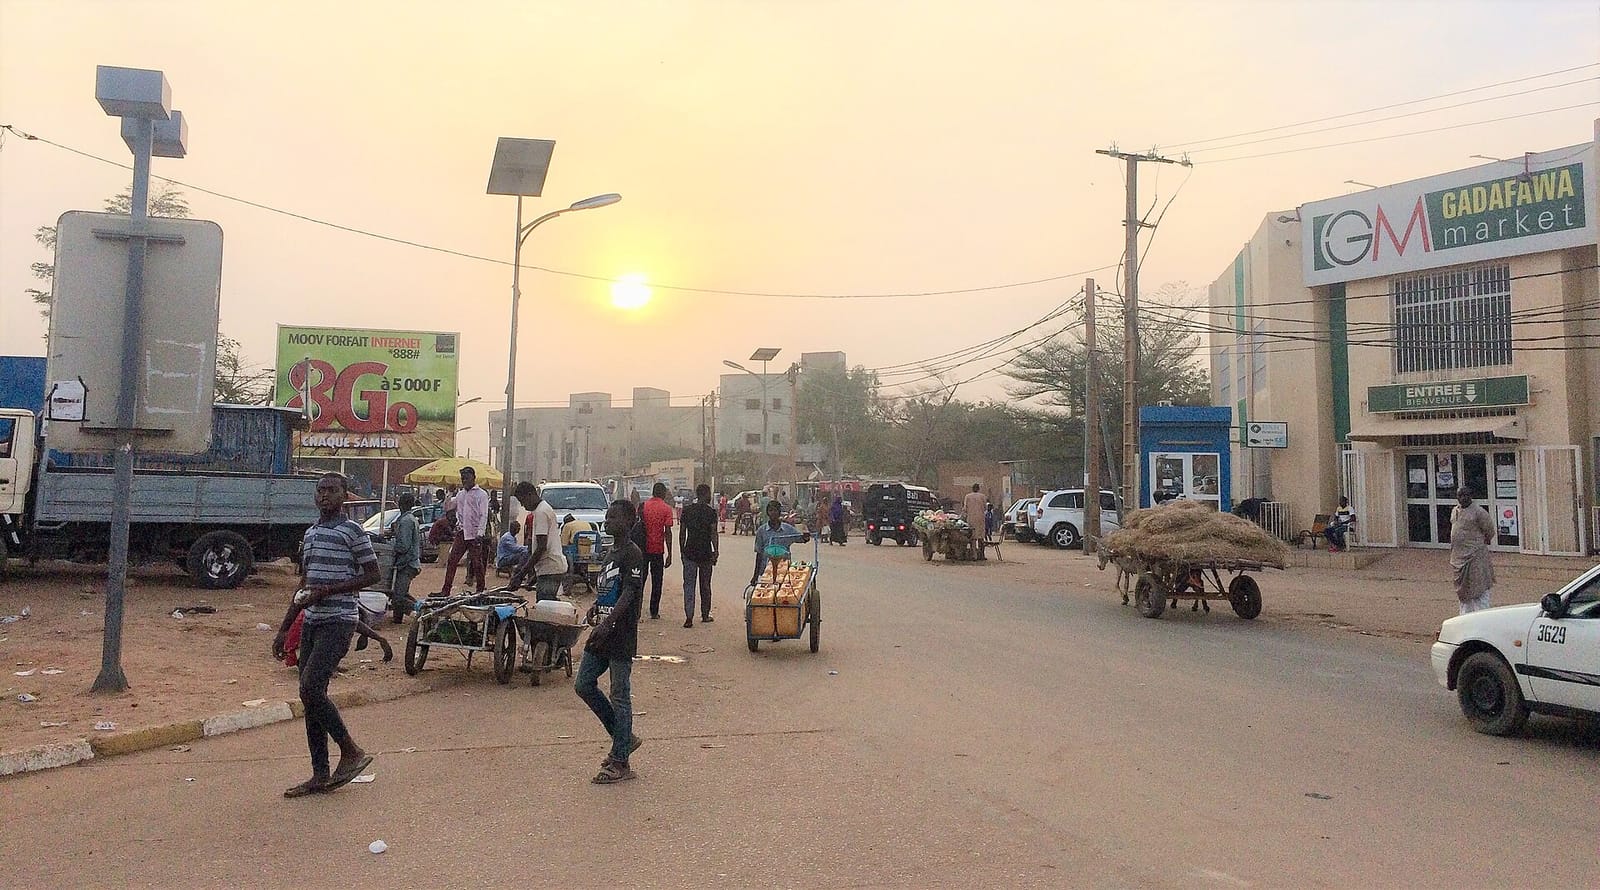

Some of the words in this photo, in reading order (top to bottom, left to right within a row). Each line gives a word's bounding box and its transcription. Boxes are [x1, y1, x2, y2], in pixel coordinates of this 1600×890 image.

[1442, 168, 1575, 220] GADAFAWA
[1443, 203, 1573, 245] market
[288, 333, 323, 346] MOOV
[326, 335, 369, 347] FORFAIT
[371, 337, 422, 349] INTERNET
[433, 379, 441, 392] F
[1406, 384, 1462, 398] ENTREE
[1406, 395, 1462, 406] BIENVENUE
[302, 435, 350, 449] CHAQUE
[353, 436, 399, 449] SAMEDI
[1537, 624, 1567, 645] 3629
